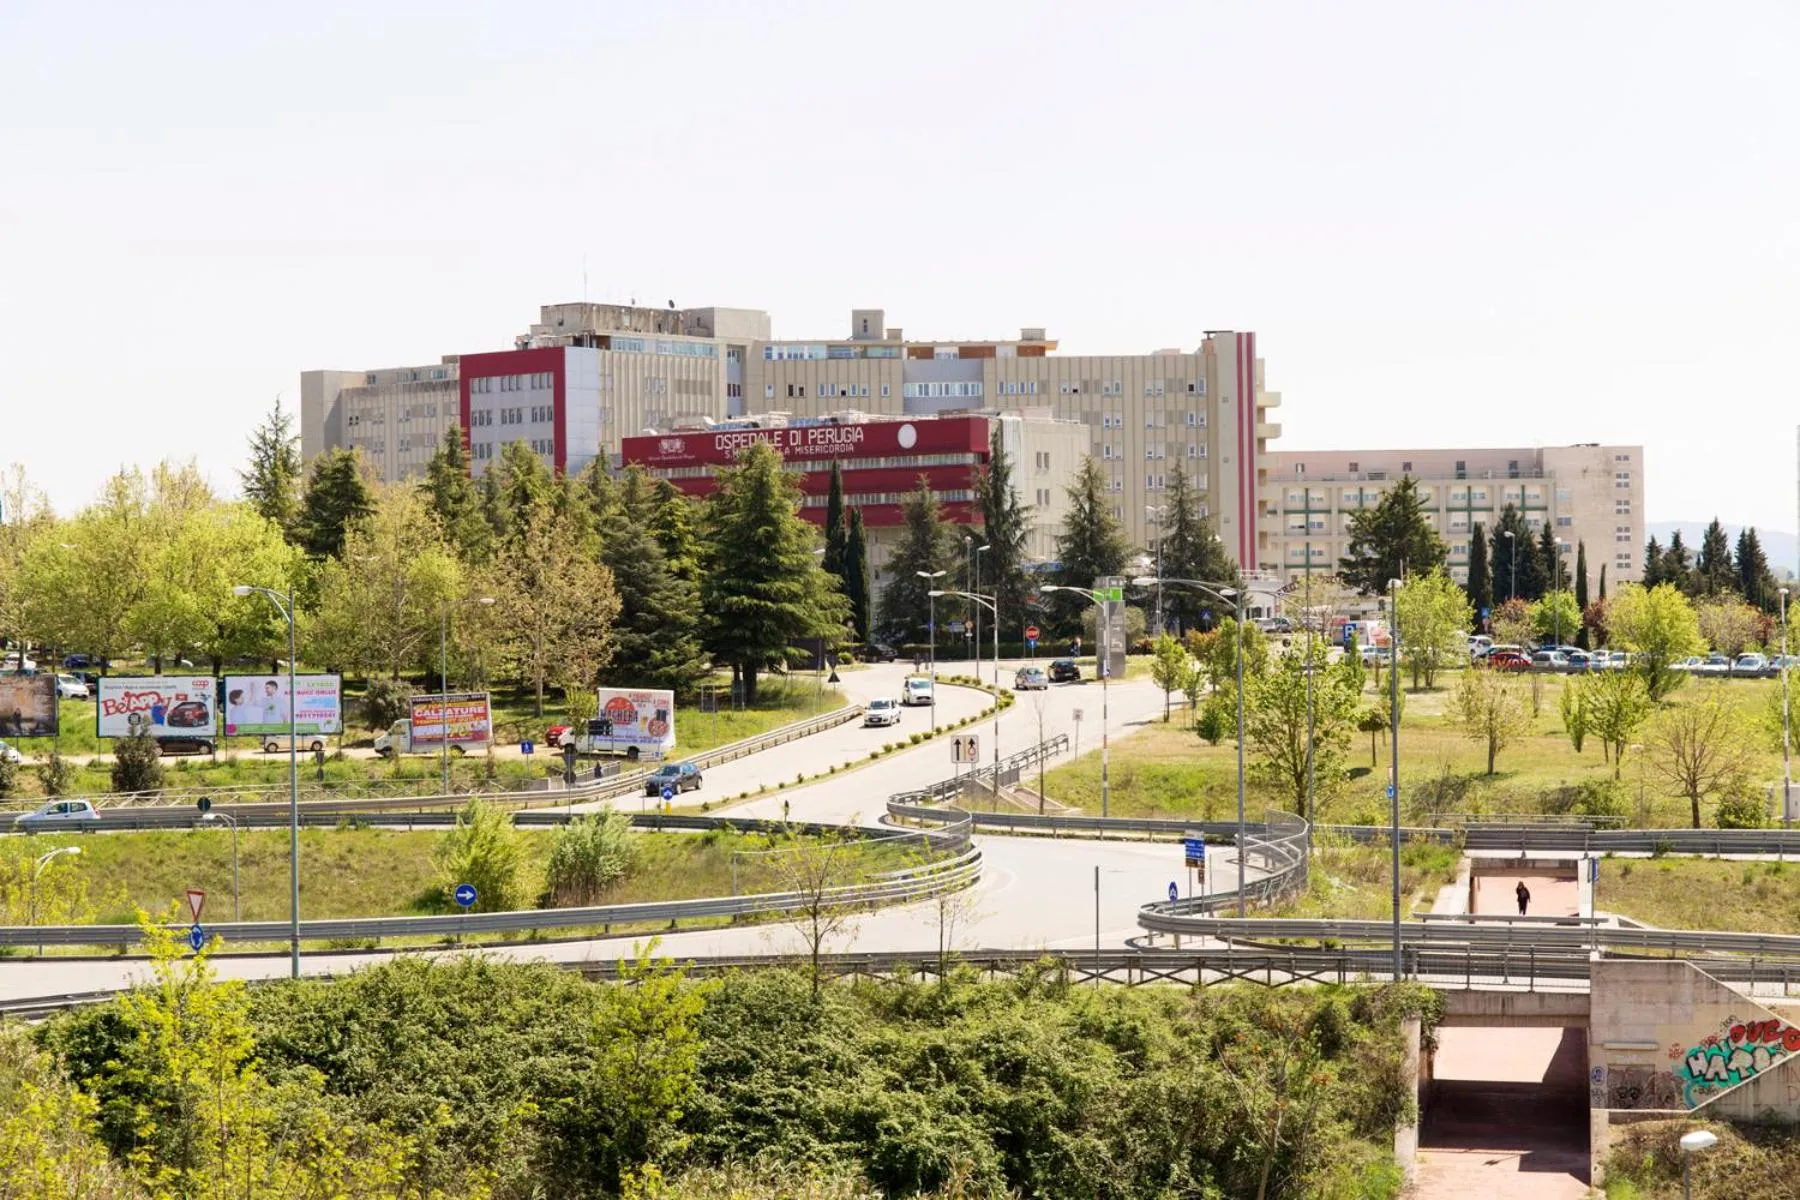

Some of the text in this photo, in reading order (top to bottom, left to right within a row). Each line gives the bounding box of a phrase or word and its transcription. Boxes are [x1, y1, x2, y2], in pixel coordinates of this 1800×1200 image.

[715, 426, 864, 450] OSPEDALE DI PERUGIA
[795, 443, 854, 455] MISERICORDIA
[1344, 625, 1354, 638] P
